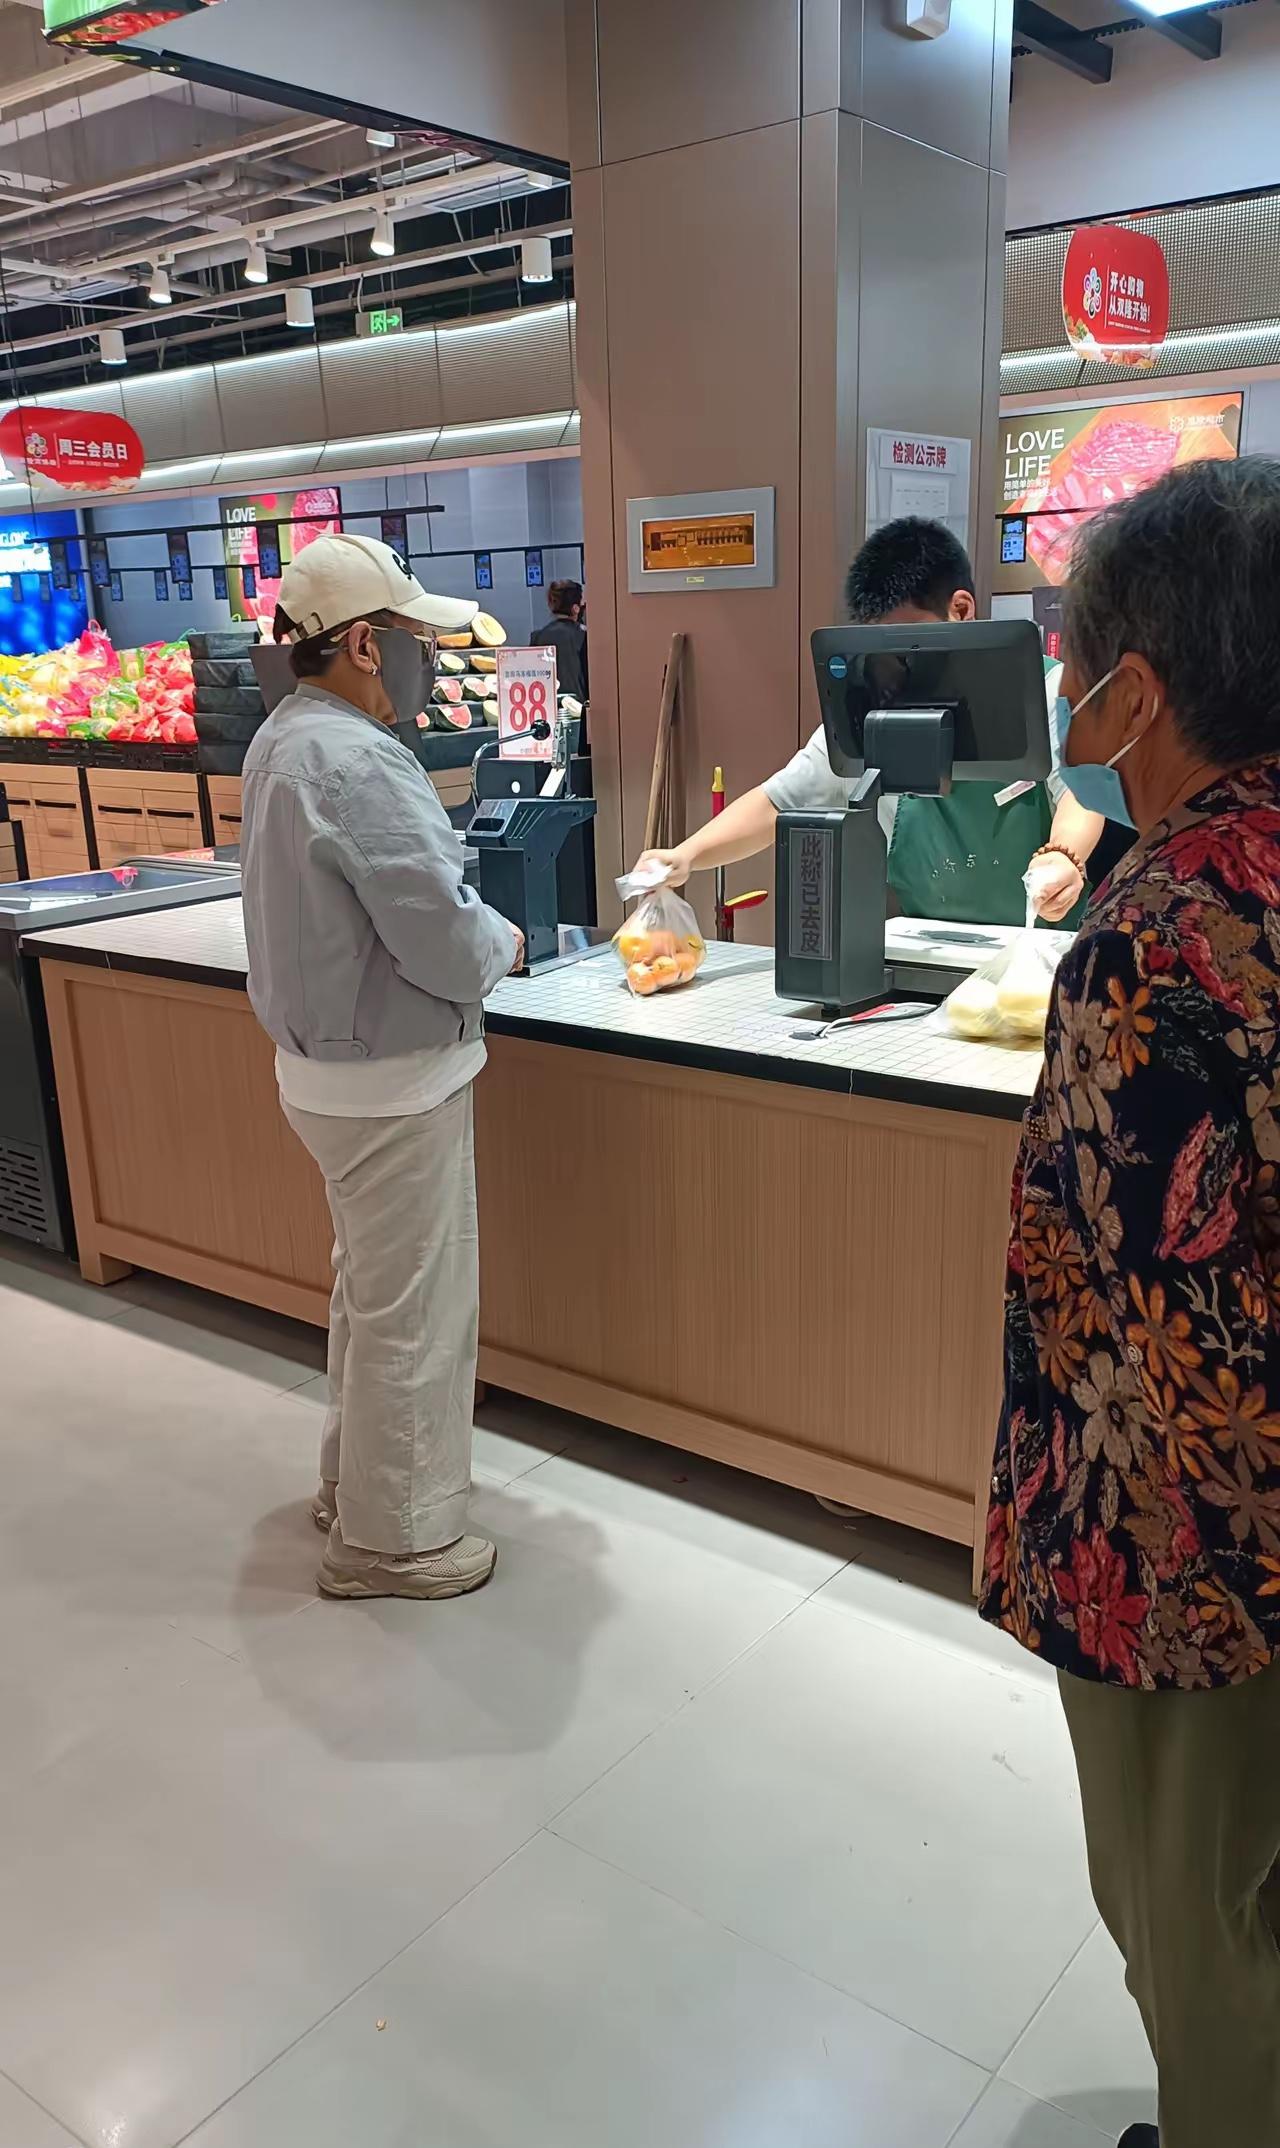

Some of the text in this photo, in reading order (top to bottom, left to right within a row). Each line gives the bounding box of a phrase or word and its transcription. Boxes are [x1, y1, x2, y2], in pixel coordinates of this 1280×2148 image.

[1110, 271, 1144, 299] 开心购物
[58, 438, 128, 460] 周三会员日
[892, 440, 947, 469] 检测公示牌
[1005, 428, 1065, 455] LOVE
[1004, 454, 1051, 480] LIFE
[226, 507, 257, 523] LOVE
[228, 527, 251, 541] LIFE
